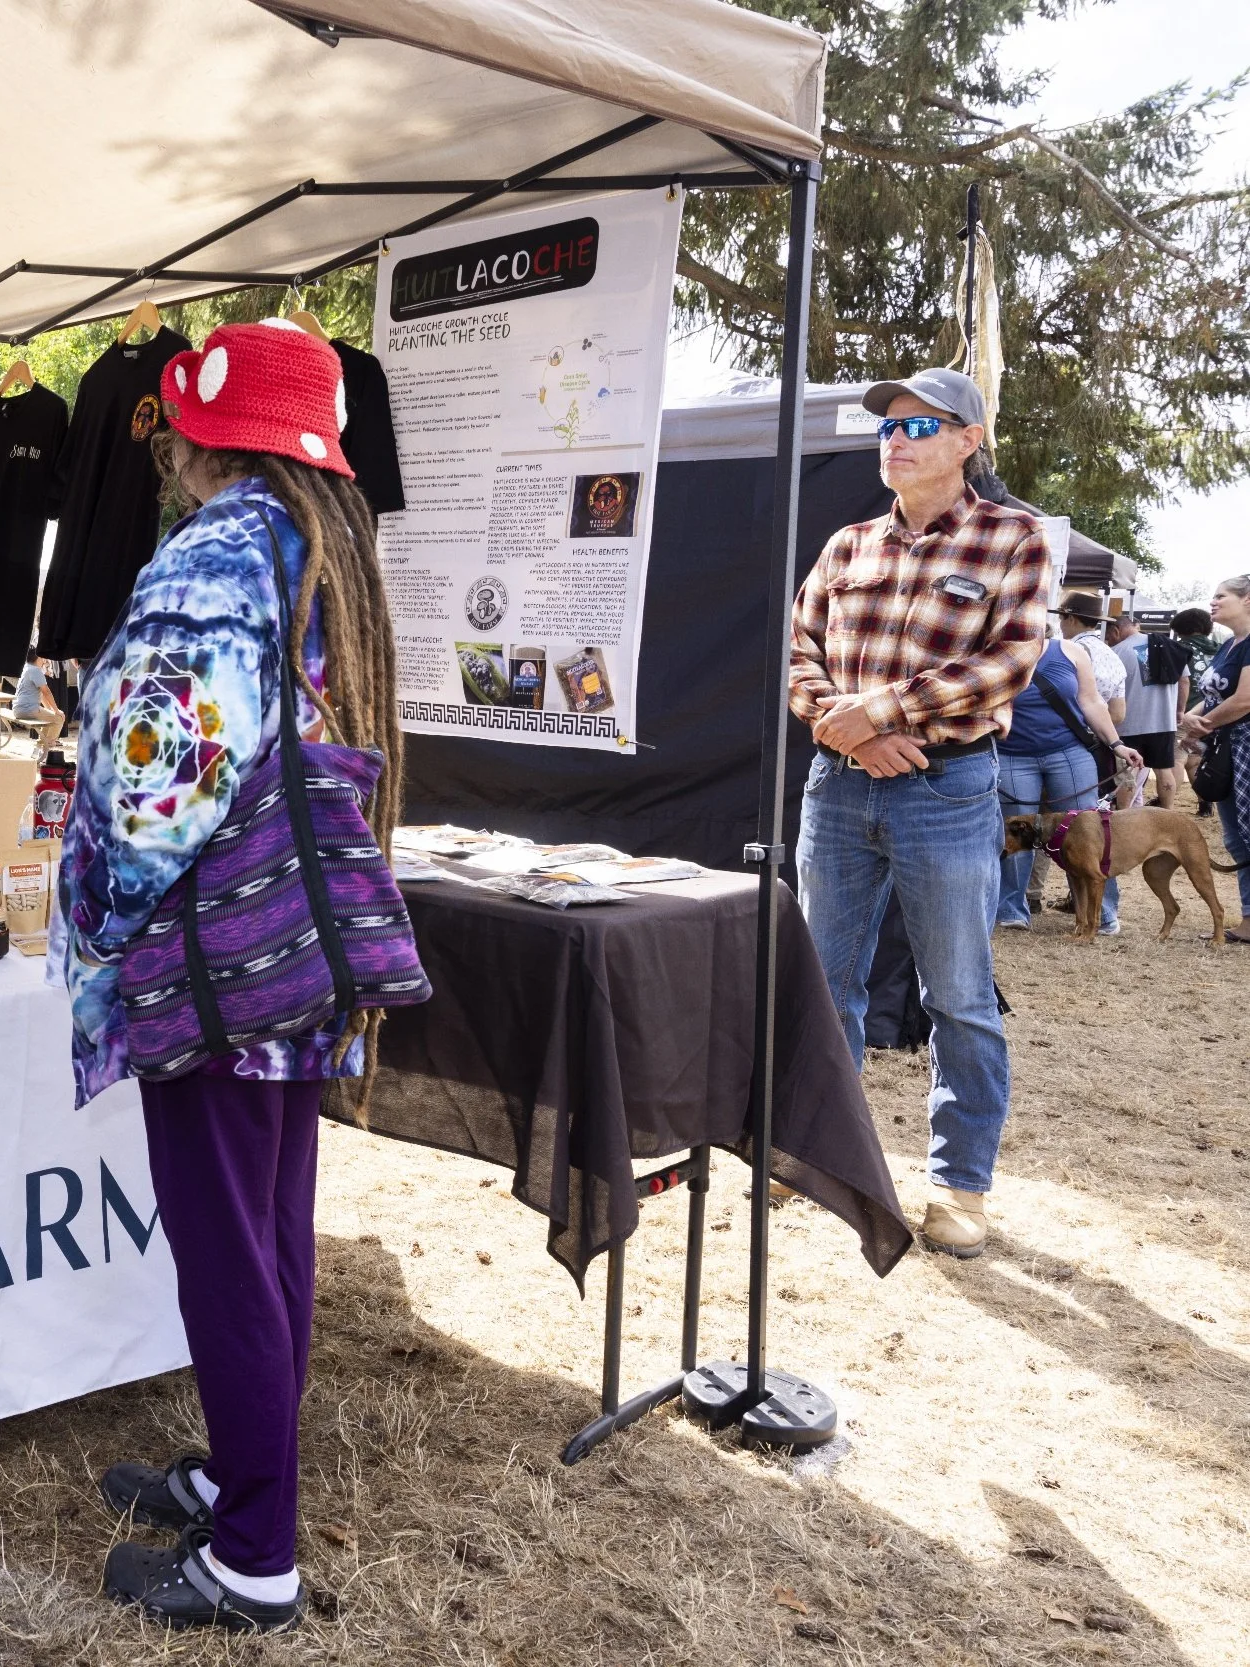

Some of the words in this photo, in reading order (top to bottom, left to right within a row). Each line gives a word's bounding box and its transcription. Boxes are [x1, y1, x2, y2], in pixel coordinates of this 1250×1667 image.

[393, 235, 594, 304] HUITLACOCHE
[390, 320, 443, 337] HUITLACOCHE
[445, 316, 479, 330] GROWTH
[481, 312, 509, 325] CYCLE
[388, 331, 447, 352] PLANTING
[450, 328, 475, 344] THE
[479, 323, 511, 342] SEED
[496, 465, 524, 473] CURRENT
[572, 548, 597, 556] HEALTH
[598, 548, 629, 556] BENEFITS
[409, 636, 443, 644] HUITLACOCHE
